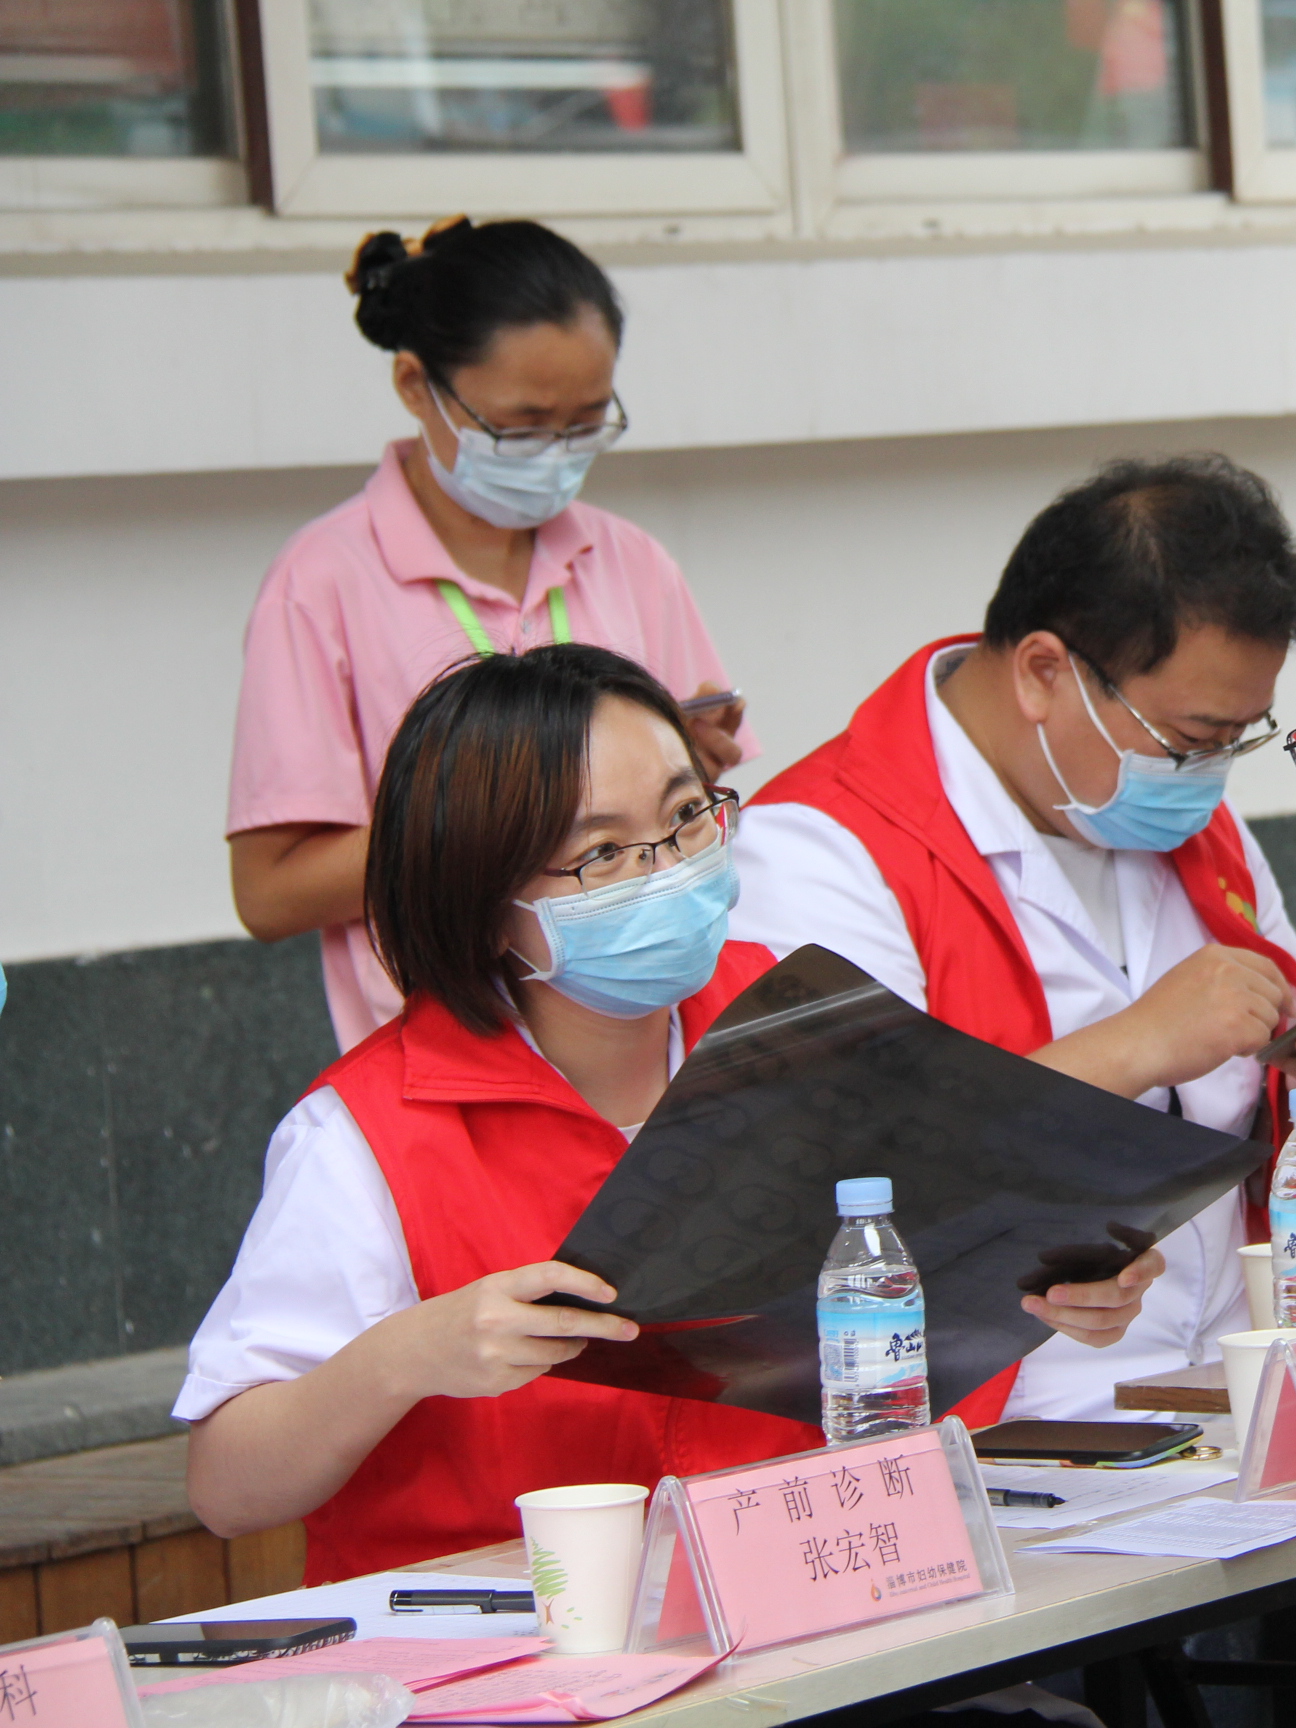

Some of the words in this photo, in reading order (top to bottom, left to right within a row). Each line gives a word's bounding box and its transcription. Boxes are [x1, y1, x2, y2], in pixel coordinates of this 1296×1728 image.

[727, 1453, 914, 1536] 产前诊断
[799, 1521, 902, 1582] 张宏智
[886, 1560, 968, 1589] 淄博市妇幼保健院
